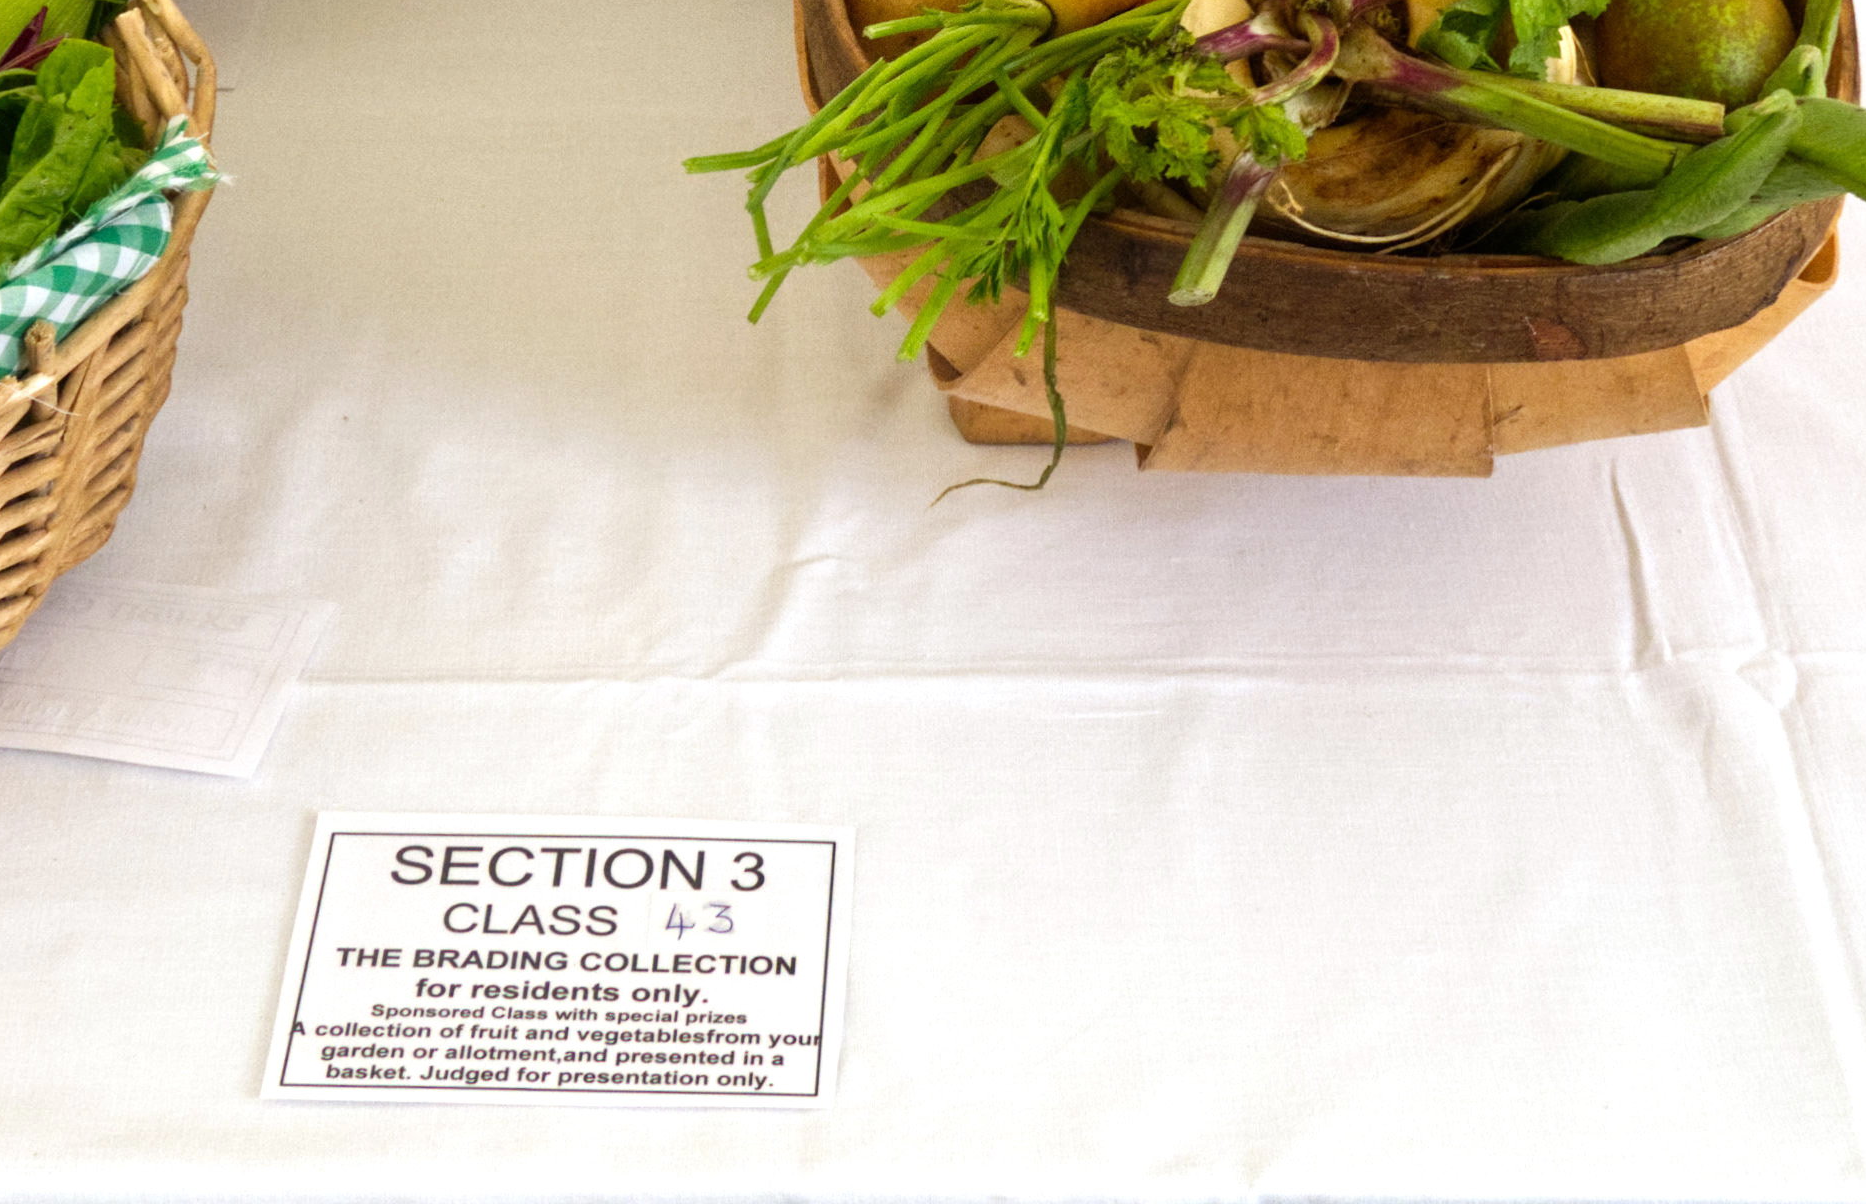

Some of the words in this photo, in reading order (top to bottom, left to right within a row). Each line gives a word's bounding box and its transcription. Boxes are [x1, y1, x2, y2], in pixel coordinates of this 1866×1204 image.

[390, 846, 706, 890] SECTION
[731, 852, 767, 892] 3
[443, 903, 619, 937] CLASS
[336, 948, 401, 968] THE
[413, 949, 568, 972] BRADING
[579, 952, 797, 976] COLLECTION
[416, 979, 460, 999] for
[471, 980, 619, 1002] residents
[633, 983, 708, 1006] only.
[371, 1004, 485, 1021] Sponsored
[491, 1006, 548, 1021] Class
[555, 1008, 598, 1022] with
[605, 1009, 680, 1027] special
[685, 1011, 748, 1028] prizes
[291, 1021, 306, 1036] A
[315, 1022, 432, 1039] collection
[440, 1024, 465, 1040] of
[471, 1025, 518, 1041] fruit
[525, 1026, 569, 1042] and
[768, 1033, 821, 1048] your
[321, 1044, 404, 1063] garden
[413, 1047, 438, 1061] or
[615, 1048, 735, 1068] presented
[743, 1051, 764, 1066] in
[771, 1055, 785, 1067] a
[326, 1064, 411, 1081] basket.
[420, 1066, 508, 1086] Judged
[517, 1068, 550, 1083] for
[558, 1069, 709, 1088] presentation
[717, 1071, 774, 1090] only.
